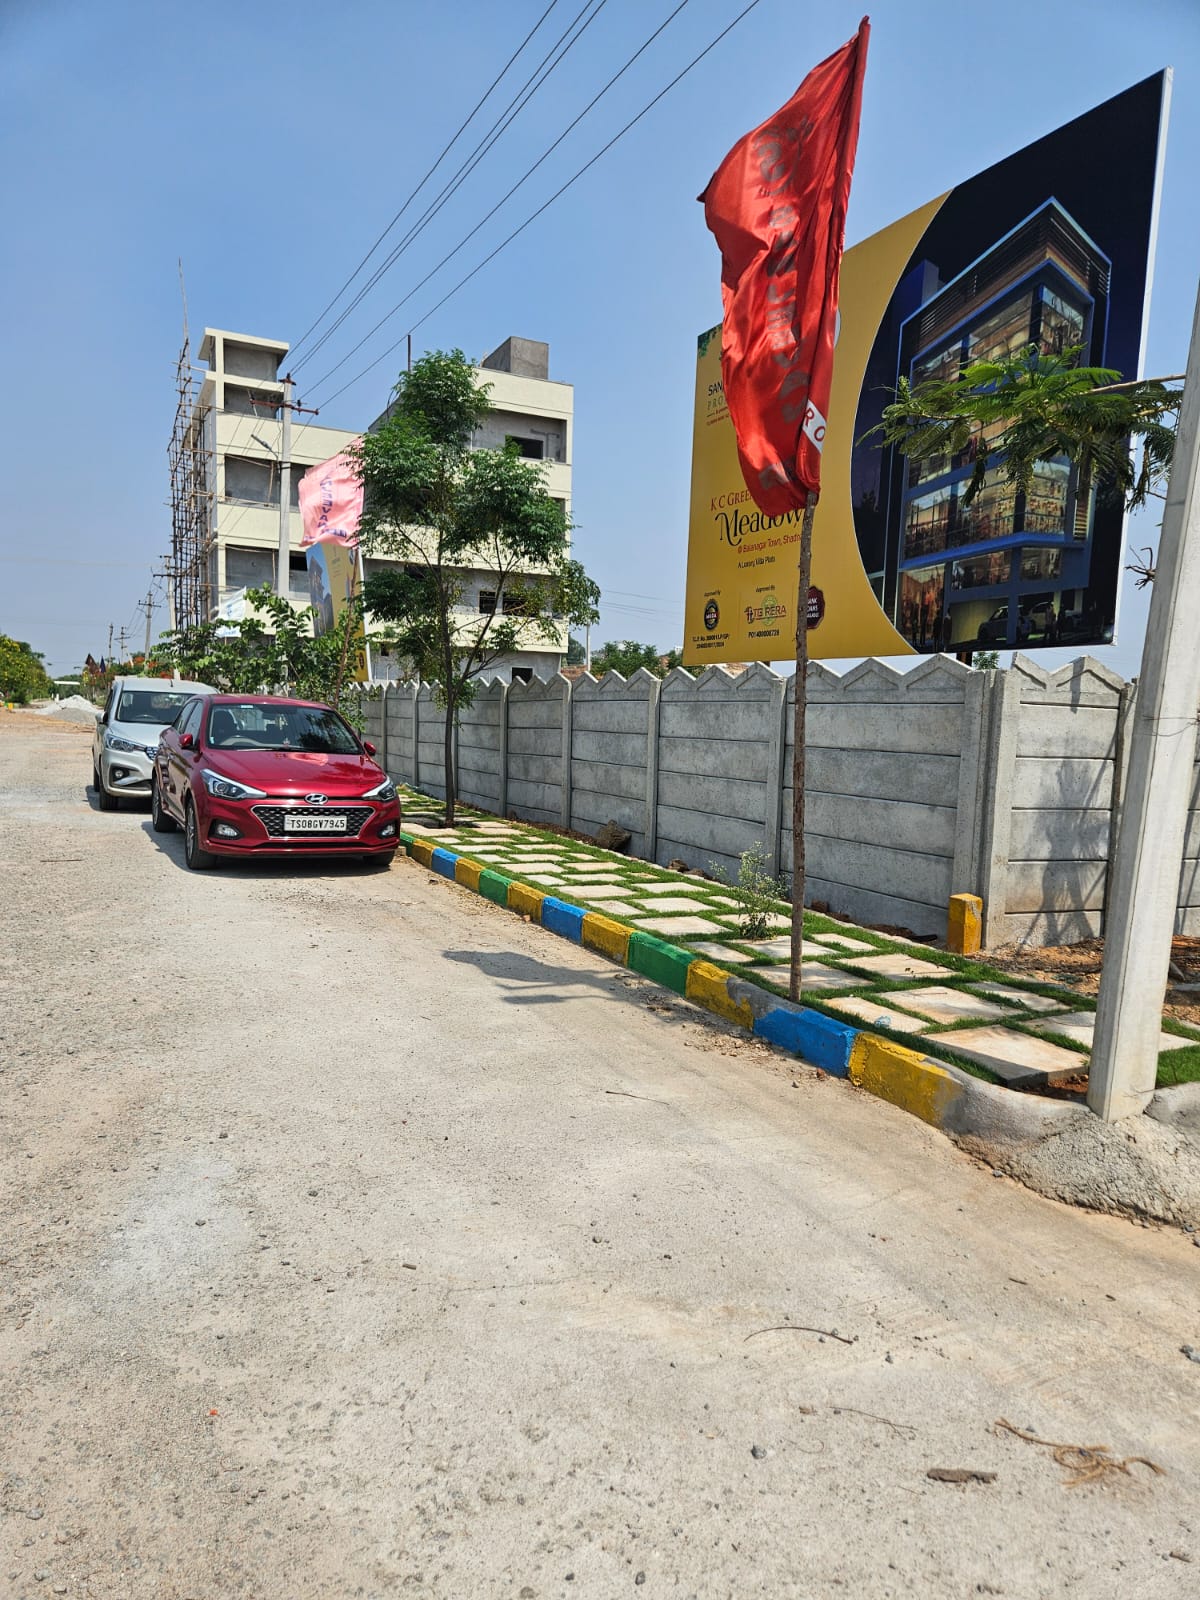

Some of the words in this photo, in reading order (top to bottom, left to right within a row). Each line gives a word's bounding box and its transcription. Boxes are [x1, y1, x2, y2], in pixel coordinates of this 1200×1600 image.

[727, 489, 752, 506] GREE
[764, 605, 787, 617] RERA
[291, 819, 345, 829] TS08GV7945
